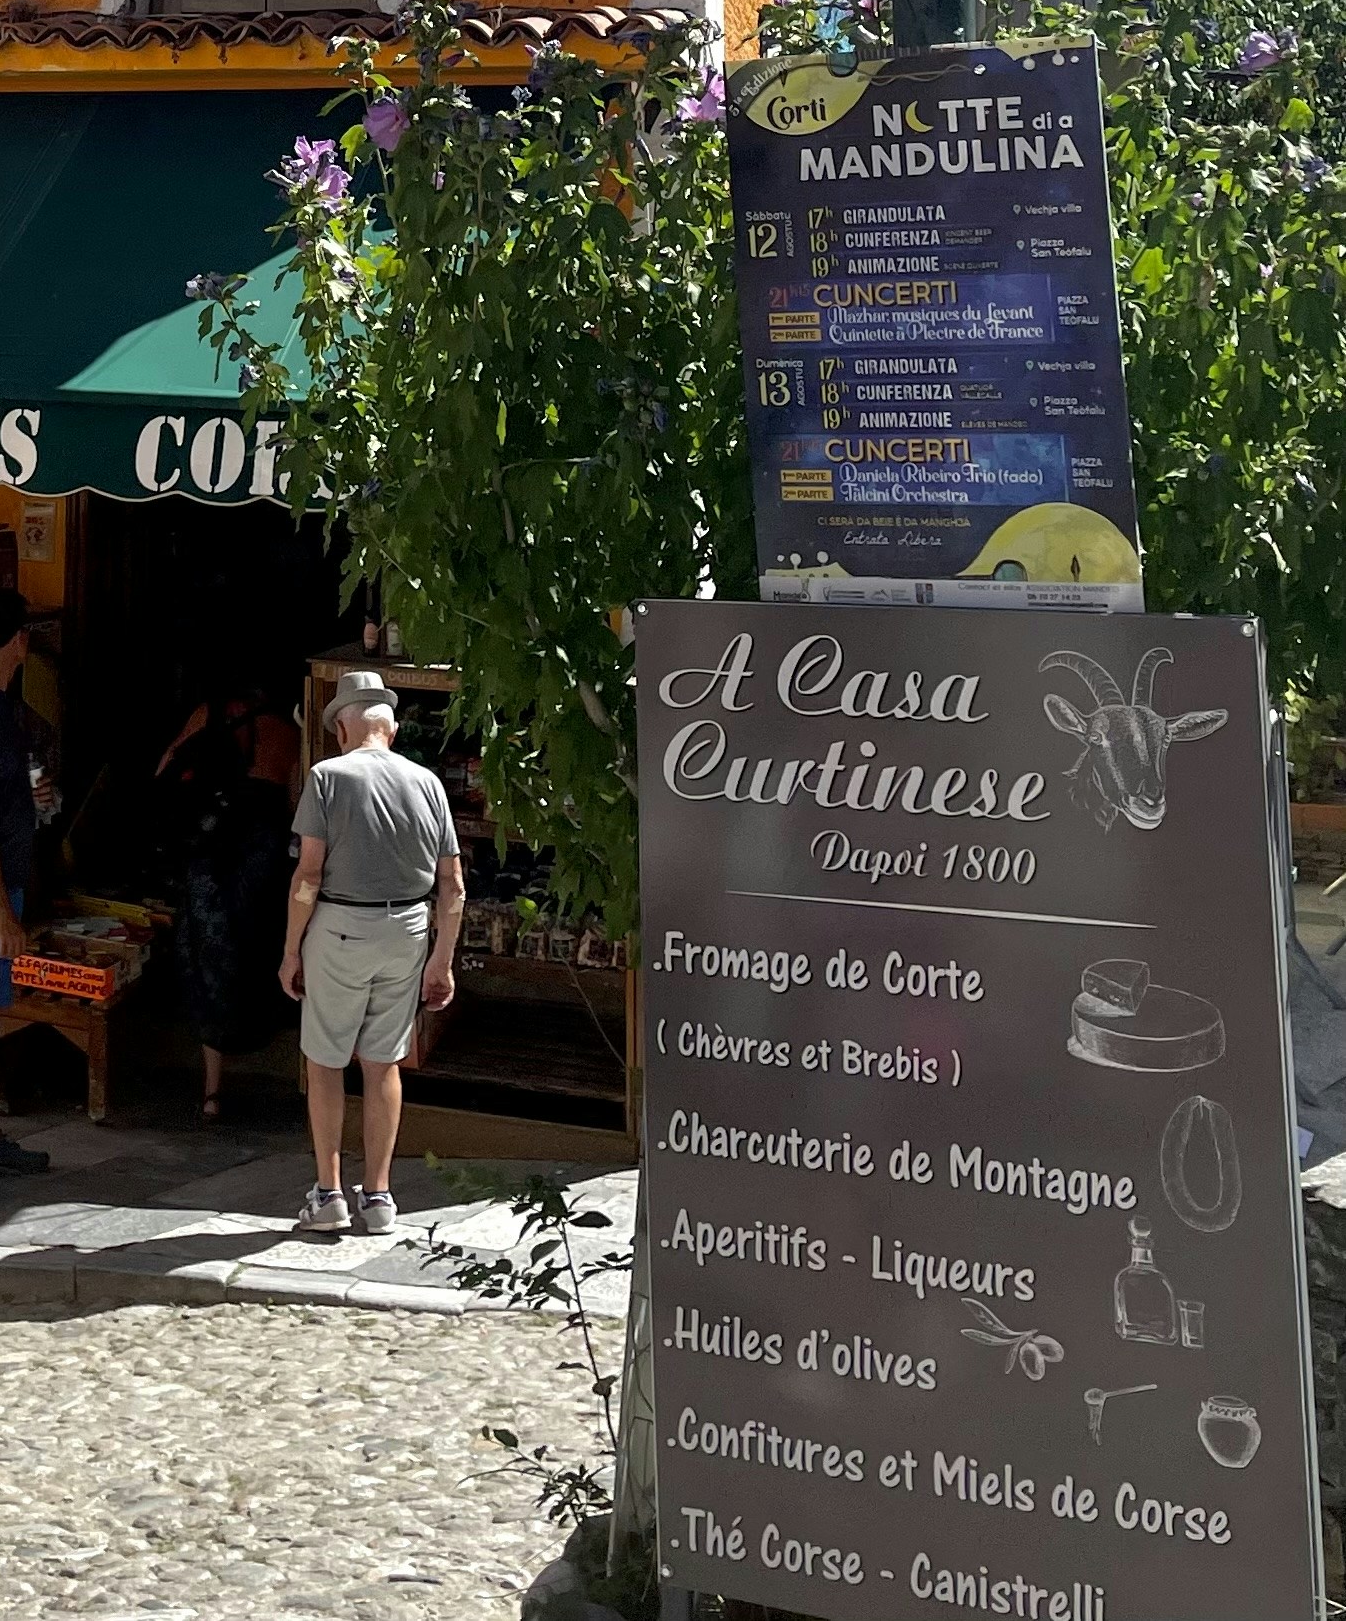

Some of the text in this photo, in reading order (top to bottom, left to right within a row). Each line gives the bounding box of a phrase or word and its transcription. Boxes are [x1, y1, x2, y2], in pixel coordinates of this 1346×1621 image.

[766, 95, 828, 130] Corti
[1031, 110, 1054, 130] di
[1058, 114, 1073, 129] a
[799, 134, 1084, 182] MANDULINA
[843, 205, 946, 225] GIRANDULATA
[747, 223, 778, 259] 12
[845, 229, 941, 249] CUNFERENZA
[848, 256, 940, 275] ANIMAZIONE
[1031, 248, 1052, 258] San
[813, 281, 958, 308] CUNCERTI
[785, 314, 816, 323] PARTE
[892, 306, 960, 327] musiques
[962, 304, 981, 321] du
[986, 302, 1035, 321] Levant
[1058, 306, 1077, 315] SAN
[785, 330, 816, 339] PARTE
[829, 324, 894, 345] Quintette
[907, 321, 965, 342] Plectre
[968, 323, 985, 339] de
[984, 318, 1044, 340] France
[854, 357, 958, 375] GIRANDULATA
[758, 371, 791, 407] 13
[856, 383, 954, 401] CUNFERENZA
[859, 411, 953, 429] ANIMAZIONE
[1045, 405, 1066, 416] San
[824, 437, 971, 463] CUNCERTI
[796, 471, 827, 481] PARTE
[839, 461, 1044, 486] Daniela Ribeiro Trio (fado)
[1072, 468, 1091, 477] SAN
[797, 489, 828, 499] PARTE
[891, 483, 969, 503] Orchestra
[856, 516, 871, 526] DA
[904, 516, 918, 527] DA
[658, 632, 989, 722] A Casa
[662, 720, 1052, 822] Curtinese
[810, 830, 1036, 886] Dapoi 1800
[825, 948, 869, 990] de
[883, 951, 985, 1002] Corte
[801, 1038, 831, 1072] et
[888, 1140, 934, 1185] de
[949, 1143, 1138, 1215] Montagne
[871, 1235, 1036, 1302] Liqueurs
[879, 1448, 918, 1490] et
[933, 1450, 1036, 1513] Miels
[1051, 1475, 1099, 1522] de
[1113, 1483, 1232, 1546] Corse
[760, 1523, 865, 1585] Corse
[910, 1552, 1106, 1621] Canistrelli
